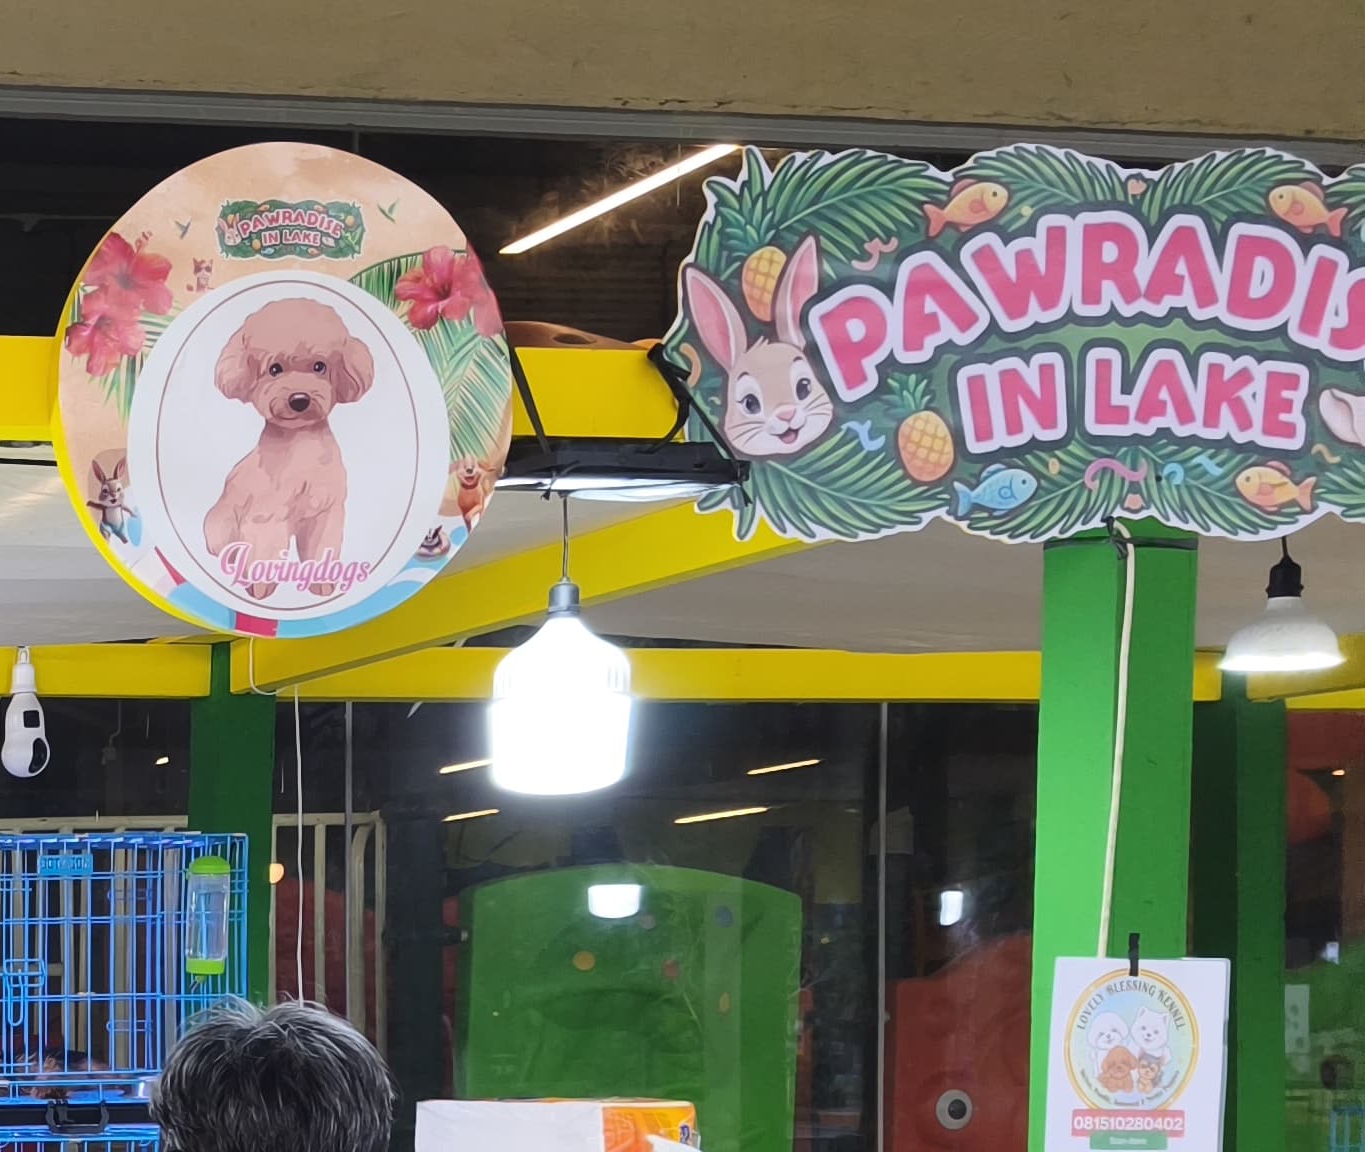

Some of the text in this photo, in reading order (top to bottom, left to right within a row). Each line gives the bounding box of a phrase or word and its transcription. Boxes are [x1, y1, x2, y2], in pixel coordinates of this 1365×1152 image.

[238, 210, 344, 238] PAWRADISE
[262, 231, 321, 245] IN LAKE
[962, 355, 1305, 447] IN LAKE
[220, 542, 371, 592] Lovingdogs
[1077, 993, 1104, 1030] LOVELY
[1073, 1115, 1184, 1131] 081510280402
